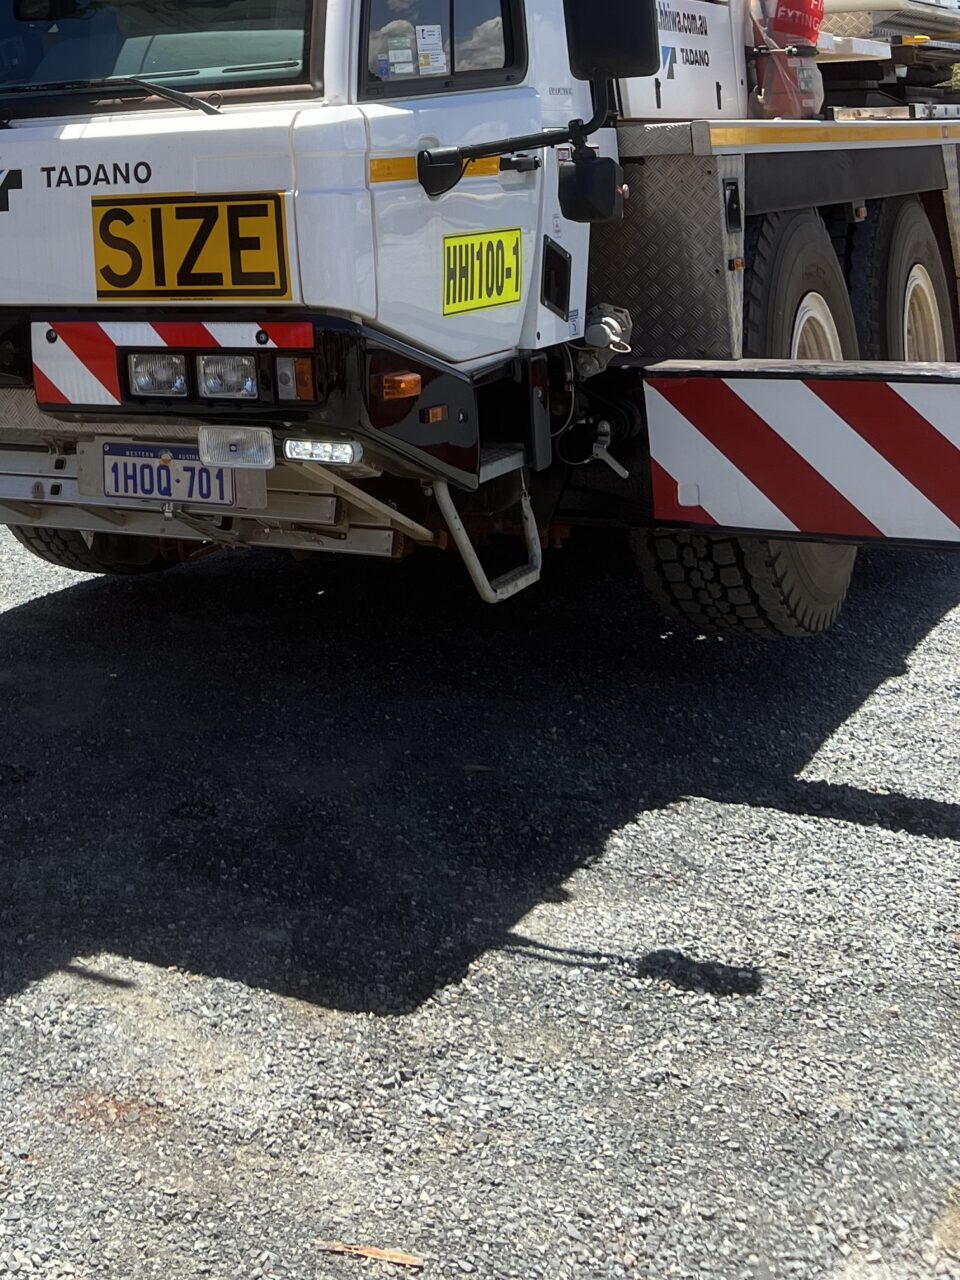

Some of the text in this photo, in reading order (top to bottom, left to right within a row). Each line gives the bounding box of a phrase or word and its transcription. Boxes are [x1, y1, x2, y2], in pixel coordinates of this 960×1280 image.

[656, 1, 708, 36] .hhiwa.com.au
[777, 6, 821, 32] EXTING
[680, 48, 710, 67] TADANO
[41, 161, 152, 188] TADANO
[99, 204, 276, 288] SIZE
[446, 237, 519, 305] HHI100-1
[112, 462, 225, 500] 1HOQ 701
